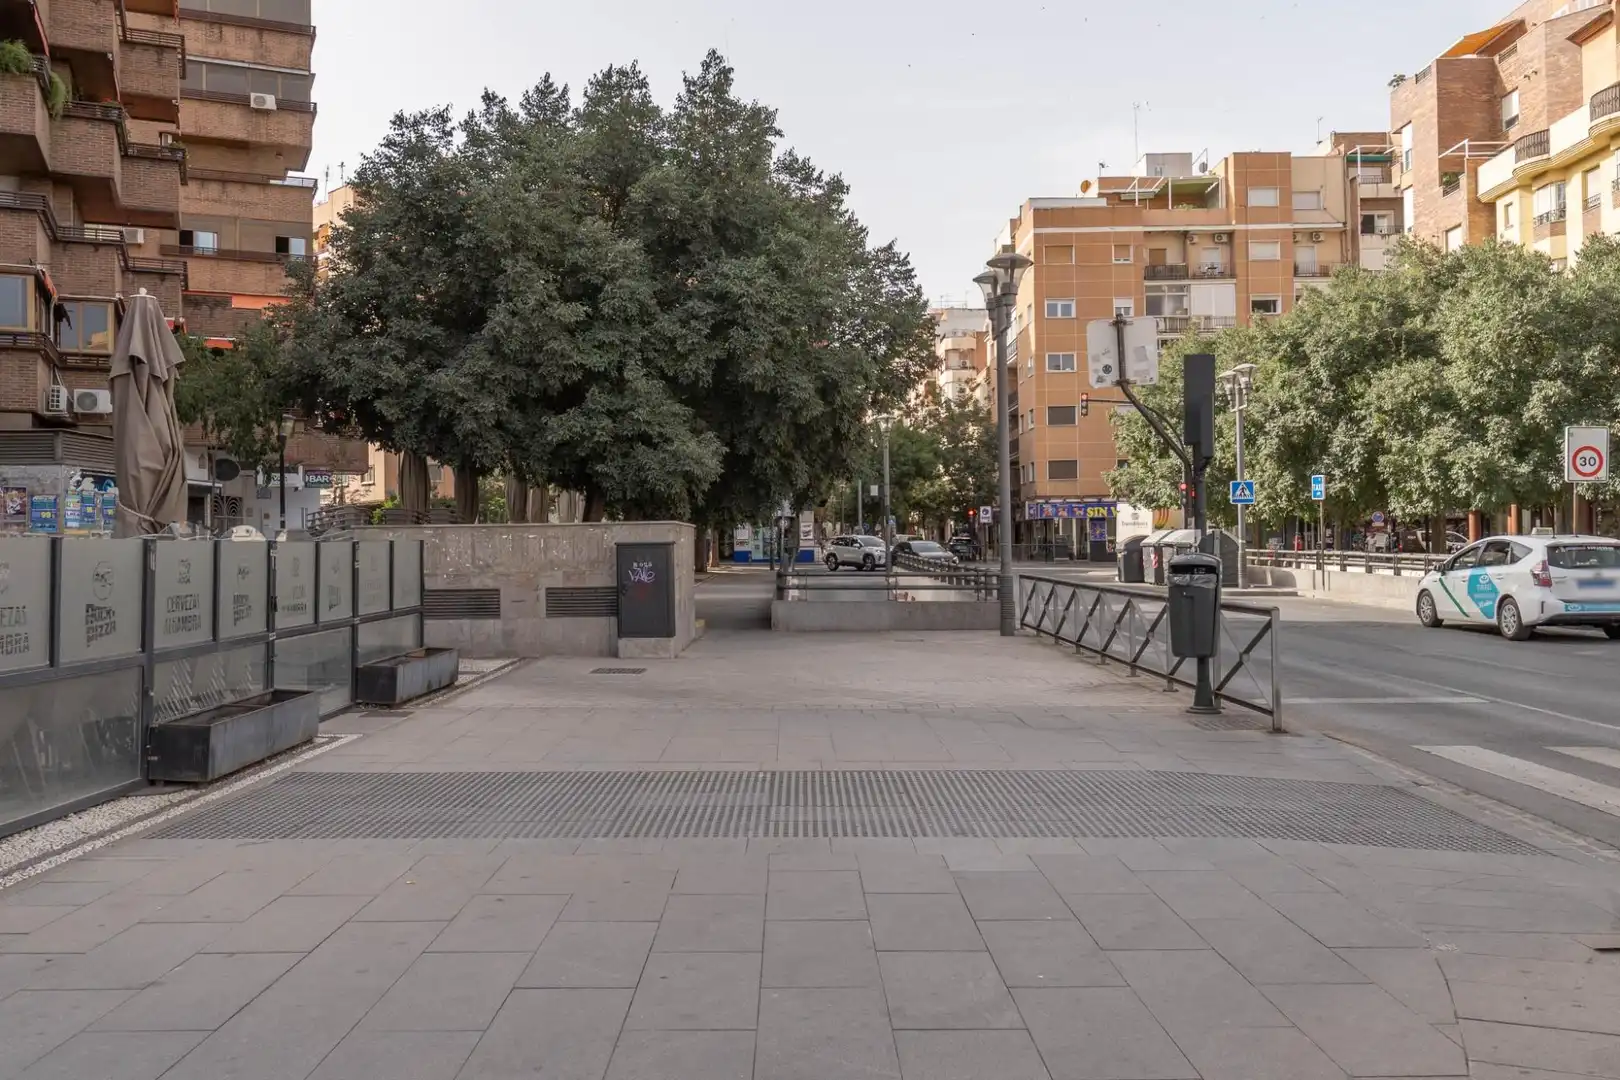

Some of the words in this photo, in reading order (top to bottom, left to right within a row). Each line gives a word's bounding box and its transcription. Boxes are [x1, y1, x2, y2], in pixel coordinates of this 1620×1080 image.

[1579, 456, 1597, 467] 30
[309, 475, 329, 483] BAR
[1087, 506, 1108, 518] SIN
